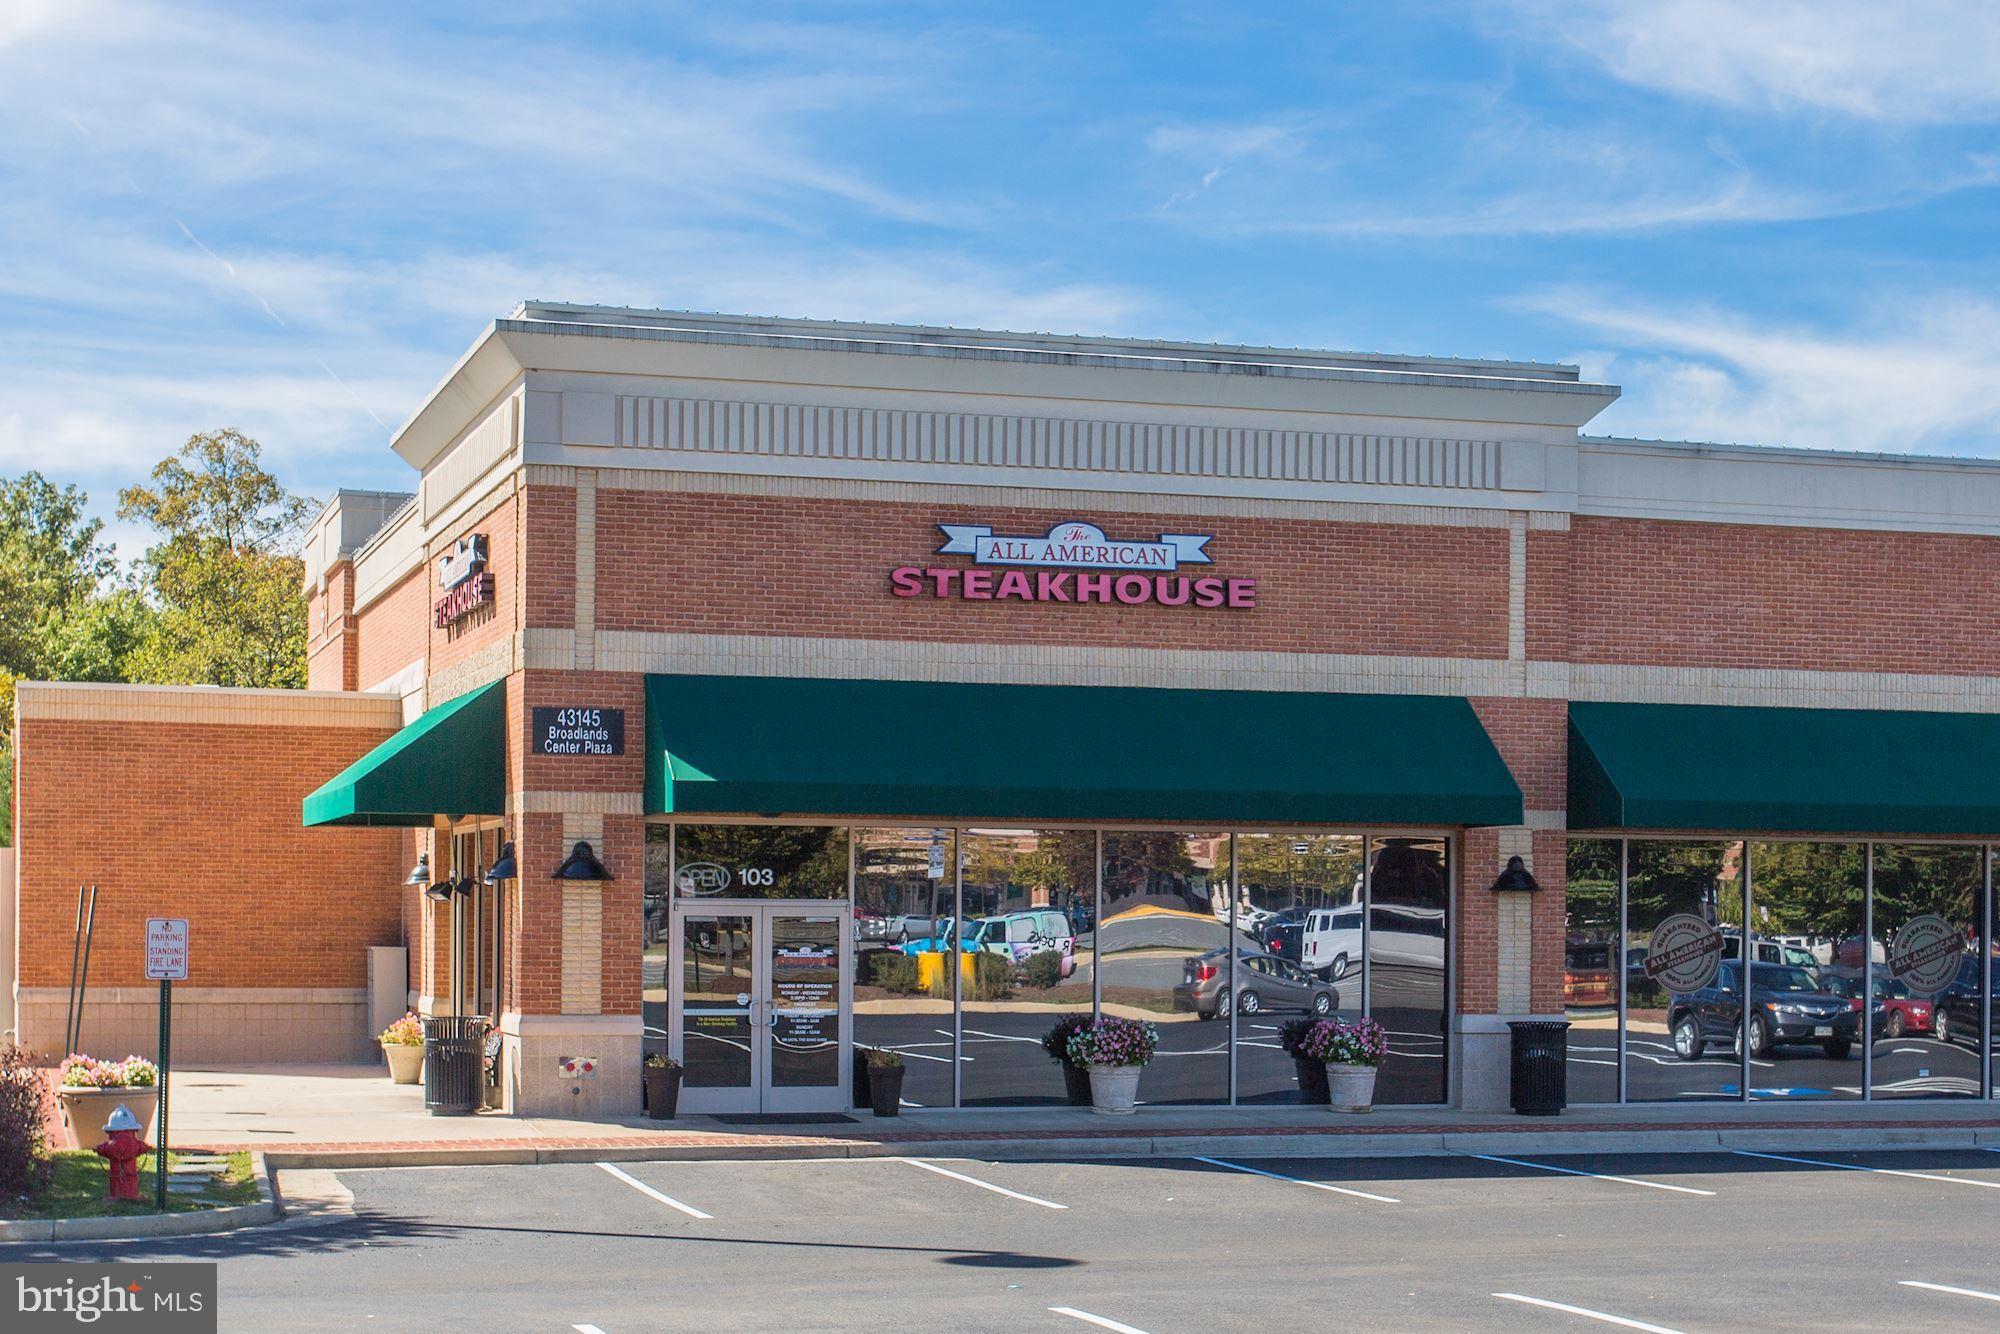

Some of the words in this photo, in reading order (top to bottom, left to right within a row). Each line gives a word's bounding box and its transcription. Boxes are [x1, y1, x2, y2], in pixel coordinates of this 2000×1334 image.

[1063, 525, 1091, 543] The
[987, 541, 1035, 561] ALL
[1041, 543, 1168, 567] AMERICAN
[890, 566, 1257, 608] STEAKHOUSE
[557, 708, 601, 727] 43145
[548, 725, 609, 741] Broadlands
[544, 739, 581, 754] Center
[584, 740, 613, 755] Plaza
[679, 869, 725, 887] OPEN
[738, 868, 775, 887] 103
[151, 933, 183, 942] PARKING
[161, 924, 173, 933] NO
[1656, 922, 1701, 949] GUARANTEED
[1901, 924, 1943, 949] GUARANTEED
[150, 947, 184, 956] STANDING
[1649, 953, 1668, 969] ALL
[1668, 935, 1717, 959] AMERICAN
[1912, 936, 1959, 959] AMERICAN
[149, 957, 164, 968] FIRE
[166, 957, 183, 968] LANE
